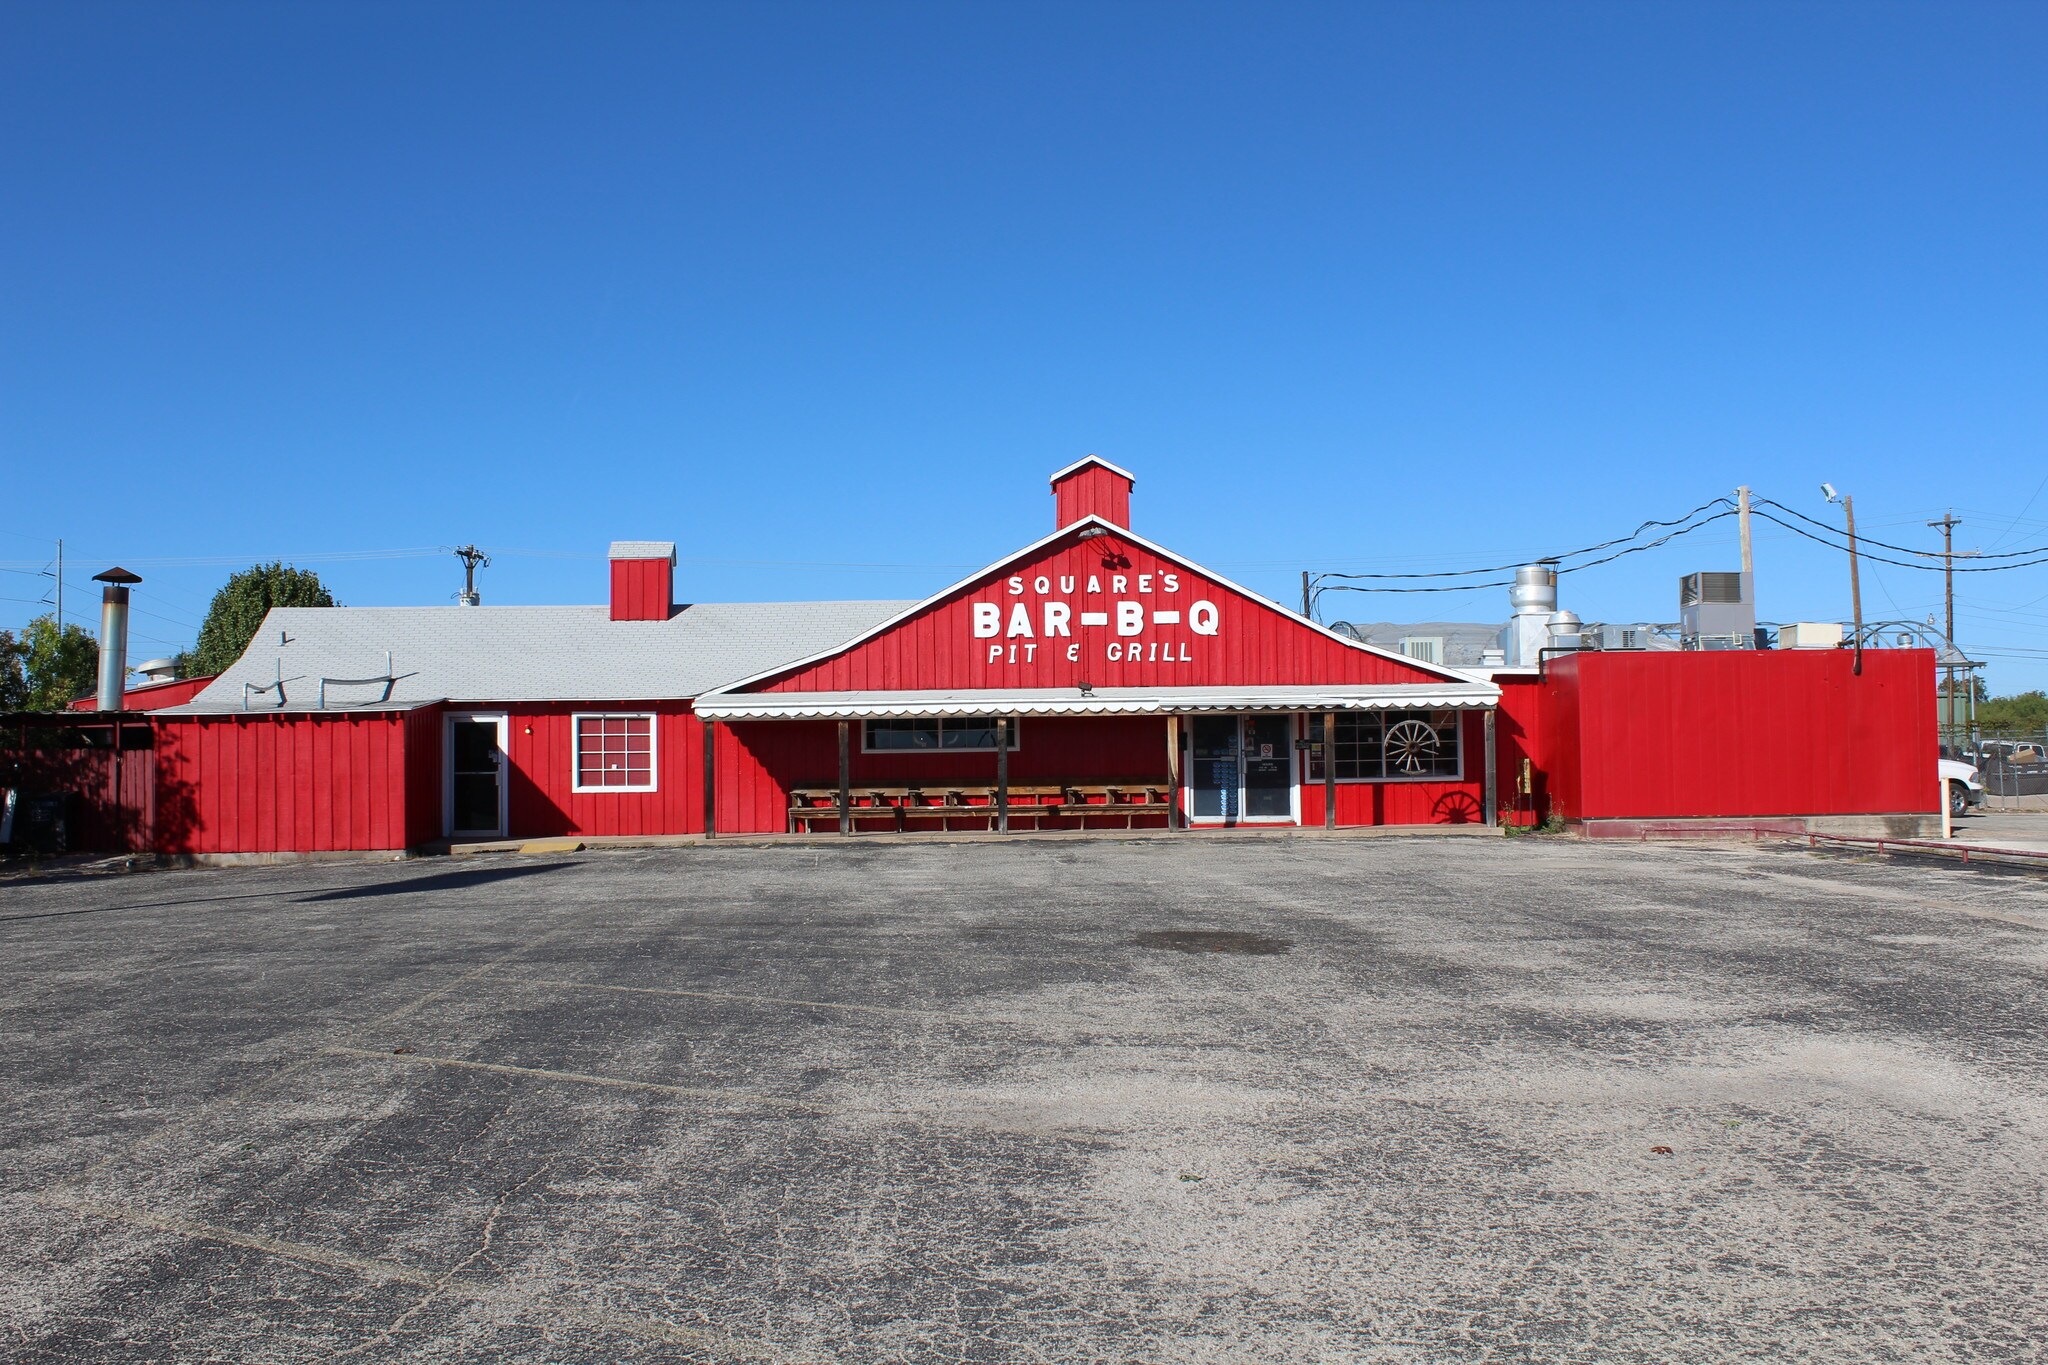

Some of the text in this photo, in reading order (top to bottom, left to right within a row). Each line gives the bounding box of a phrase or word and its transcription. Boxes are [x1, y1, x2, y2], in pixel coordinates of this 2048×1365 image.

[1008, 570, 1180, 595] SQUARE'S
[973, 600, 1219, 638] BAR-B-Q
[989, 642, 1193, 664] PIT & GRILL
